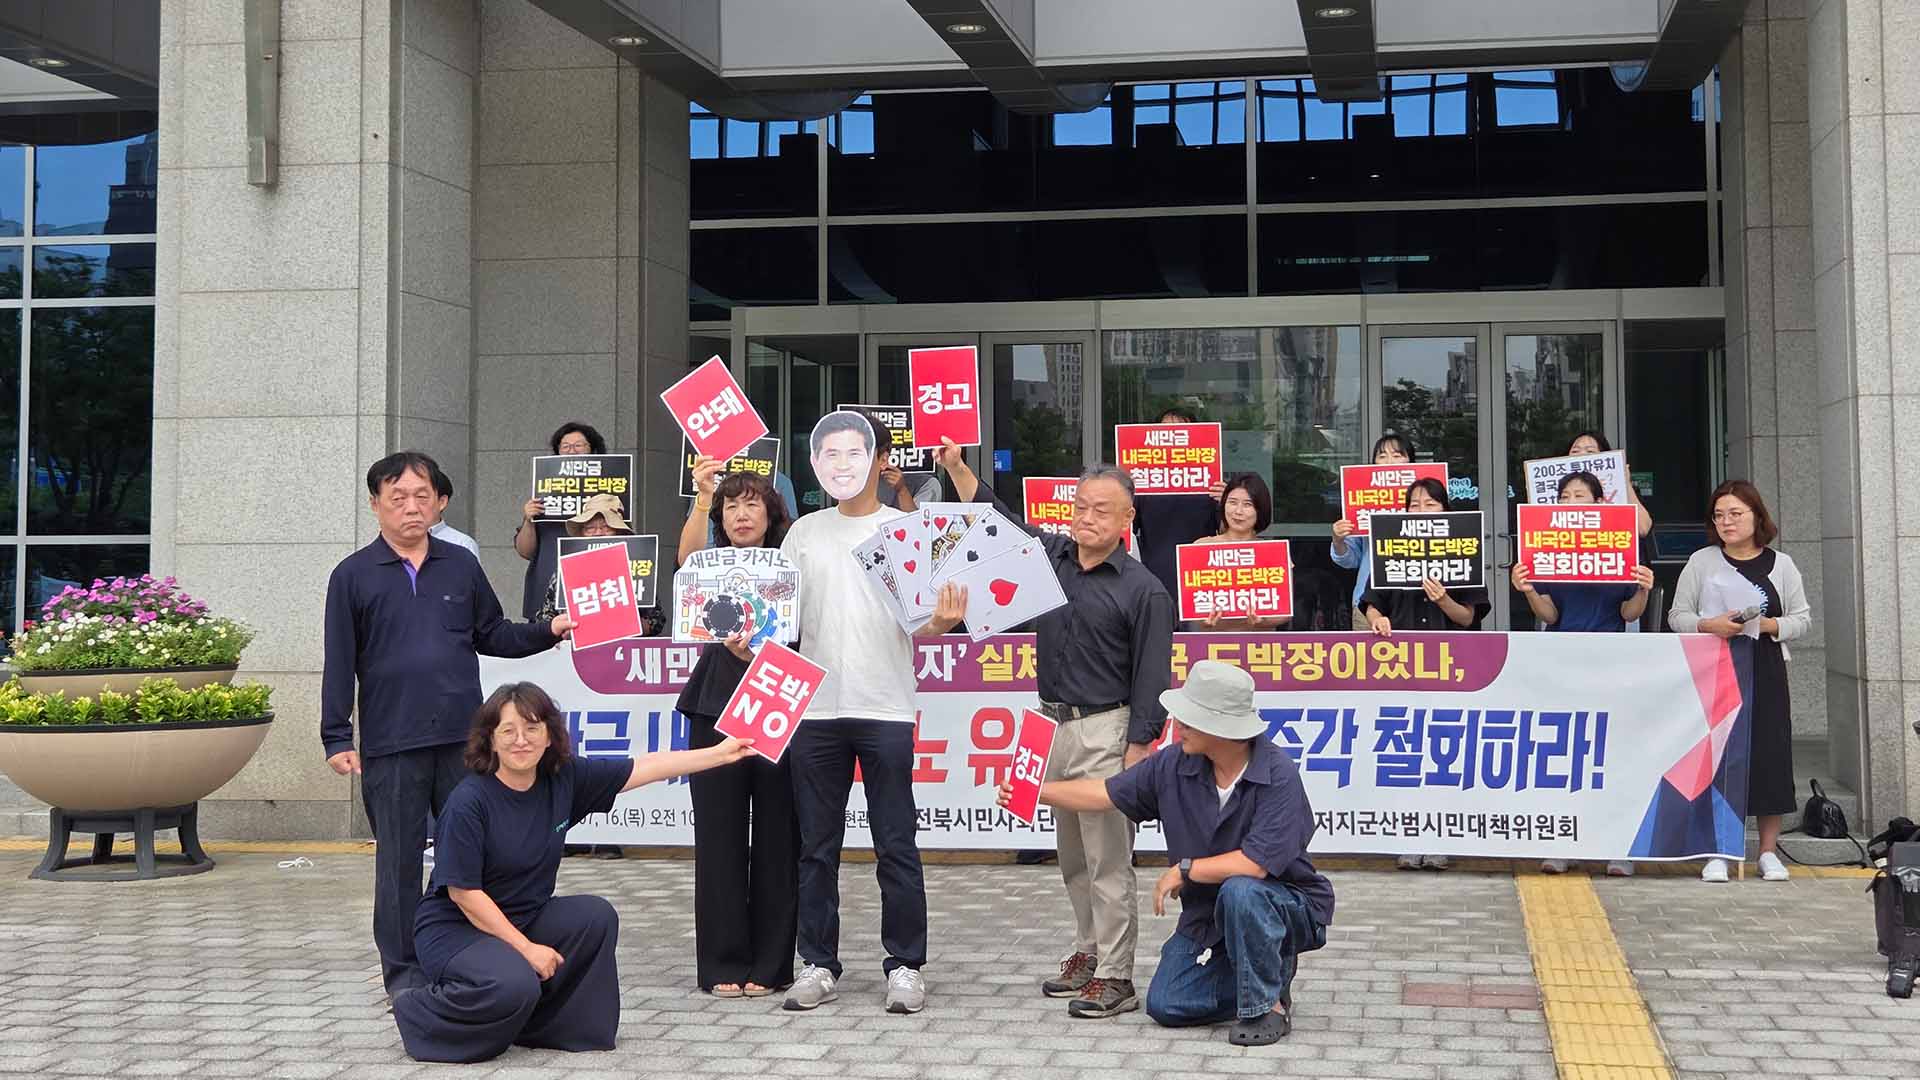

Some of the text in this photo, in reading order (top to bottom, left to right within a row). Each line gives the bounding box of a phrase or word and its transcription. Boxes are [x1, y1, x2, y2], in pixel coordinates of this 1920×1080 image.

[917, 382, 973, 415] 경고
[687, 386, 745, 440] 안돼
[1144, 430, 1190, 447] 새만금
[730, 457, 773, 476] 도박장
[887, 447, 926, 468] 하라
[1122, 447, 1217, 465] 내국인 도박장
[558, 460, 602, 477] 새만금
[1129, 466, 1212, 489] 철회하라
[1370, 470, 1417, 487] 새만금
[537, 477, 628, 494] 내국인 도박장
[543, 495, 591, 516] 철회
[1348, 489, 1394, 506] 내국인
[1031, 502, 1075, 521] 내국인
[1550, 511, 1602, 529] 새만금
[1399, 519, 1450, 537] 새만금
[1376, 537, 1479, 557] 내국인 도박장
[1525, 530, 1633, 549] 내국인 도박장
[689, 548, 789, 569] 새만금 카지노
[1207, 548, 1256, 567] 새만금
[1532, 552, 1626, 576] 철회하라
[1184, 566, 1285, 587] 내국인 도박장
[1385, 558, 1473, 583] 철회하라
[571, 575, 630, 616] 멈춰
[1193, 587, 1280, 614] 철회하라
[614, 646, 699, 685] '새만
[748, 661, 810, 713] 도박
[732, 692, 789, 739] NO
[1373, 706, 1609, 793] 철회하라!
[1014, 746, 1045, 786] 경고
[650, 808, 676, 827] 오전
[681, 810, 696, 826] 10
